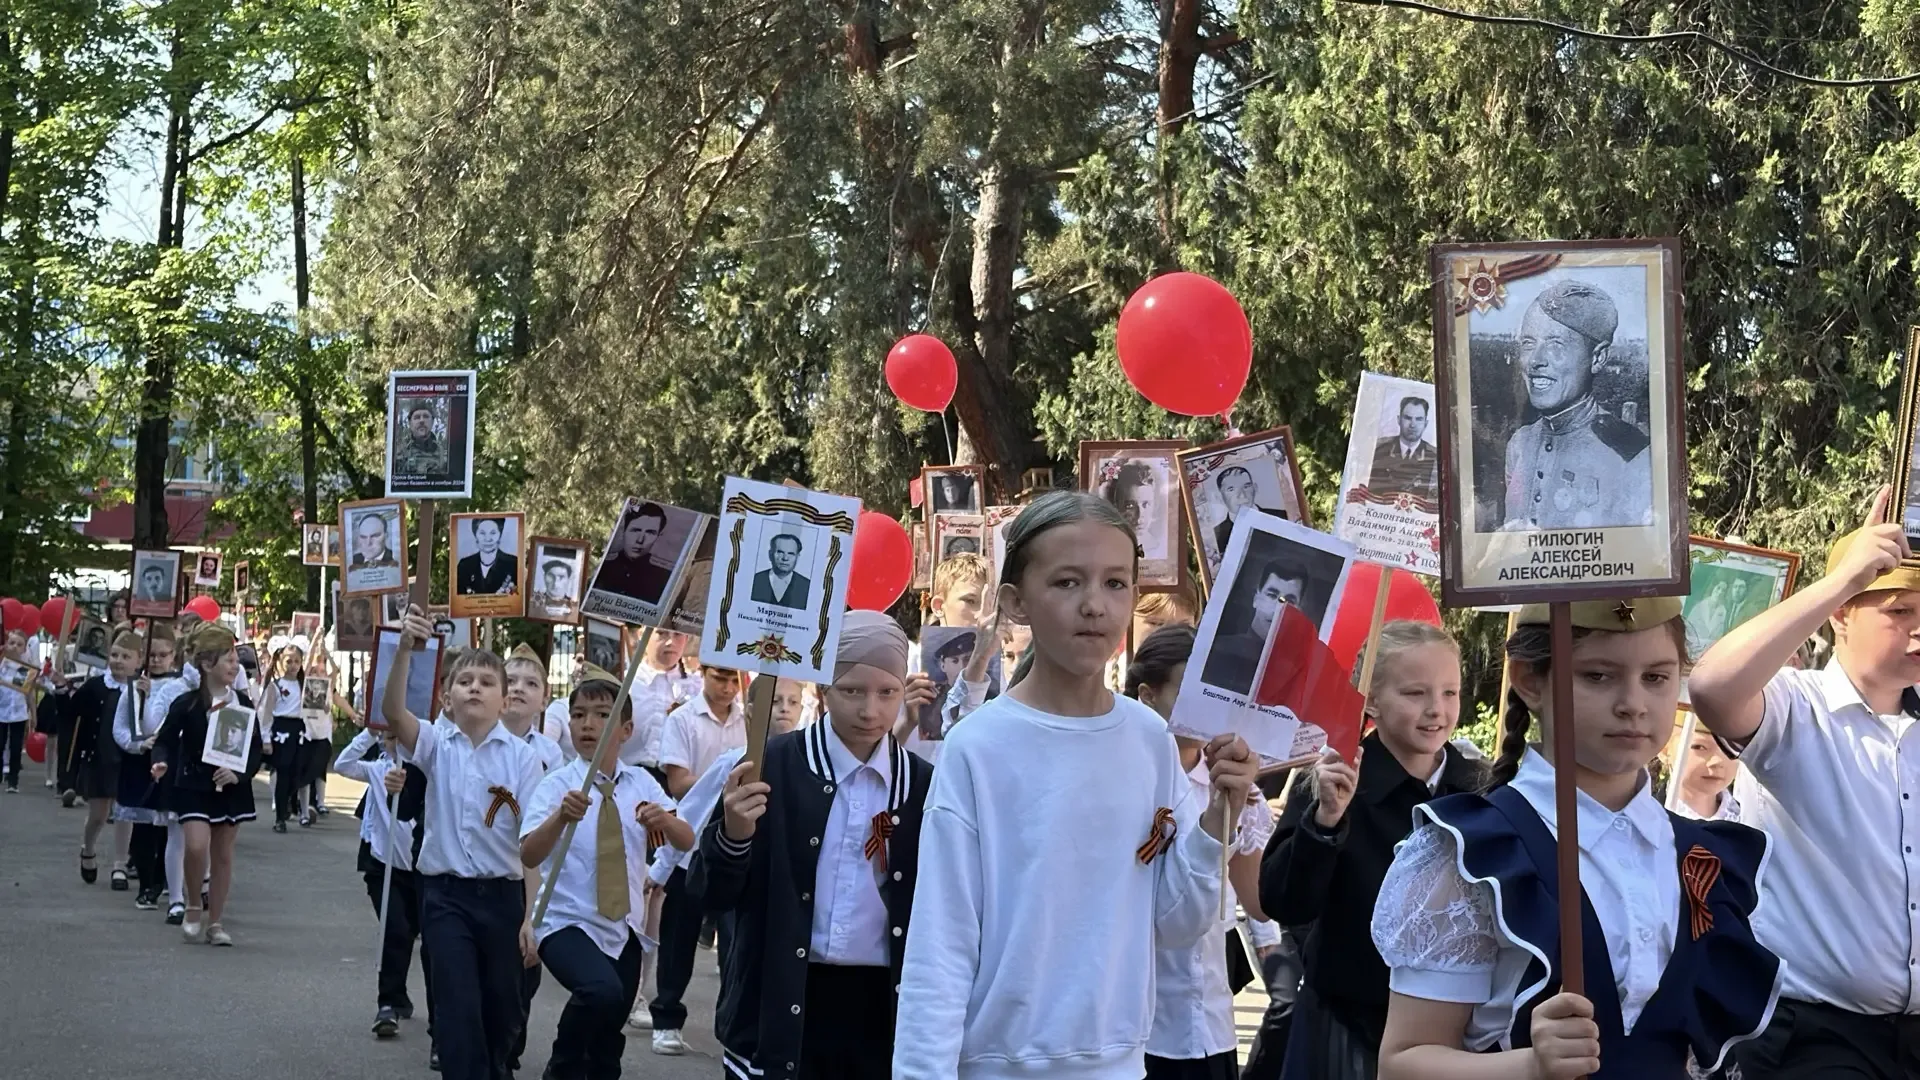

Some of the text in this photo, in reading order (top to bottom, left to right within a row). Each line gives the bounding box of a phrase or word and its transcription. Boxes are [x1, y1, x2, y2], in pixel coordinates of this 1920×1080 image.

[396, 383, 433, 392] БЕССМЕРТНЫЙ
[1347, 516, 1396, 534] Владимир
[1528, 532, 1604, 547] ПИЛЮГИН
[1530, 546, 1602, 564] АЛЕКСЕЙ
[1498, 563, 1634, 580] АЛЕКСАНДРОВИЧ
[588, 591, 613, 606] Реуш
[615, 598, 658, 618] Василий
[592, 602, 645, 623] Данилович
